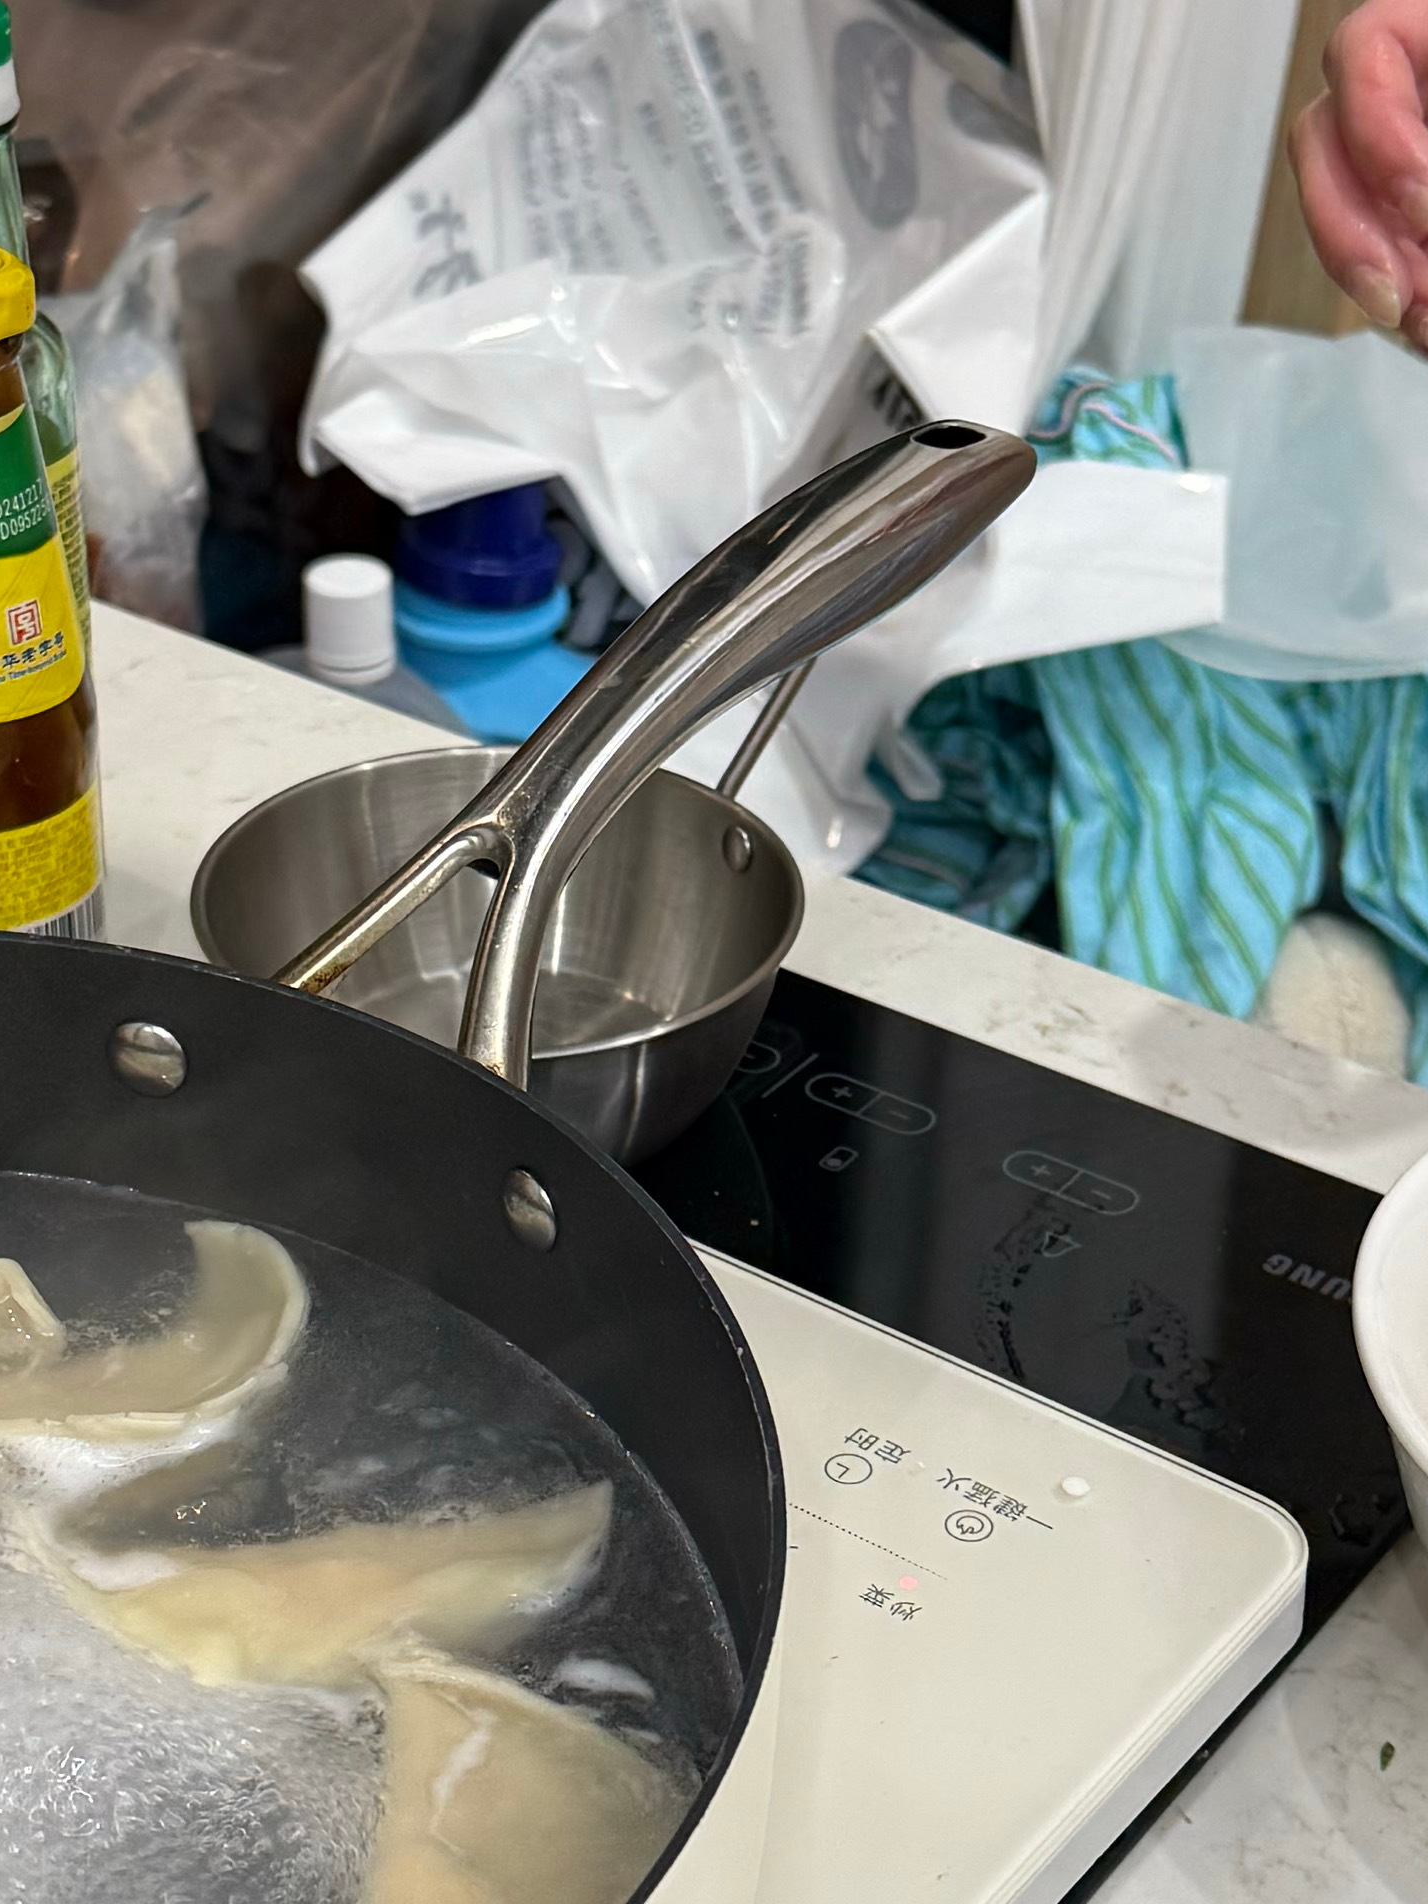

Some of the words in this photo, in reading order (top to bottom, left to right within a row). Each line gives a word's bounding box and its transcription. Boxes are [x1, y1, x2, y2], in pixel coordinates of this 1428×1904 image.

[1261, 1252, 1353, 1303] UNG
[842, 1426, 913, 1465] 定时
[934, 1466, 1055, 1531] 一键猛火
[857, 1581, 924, 1623] 炒菜
